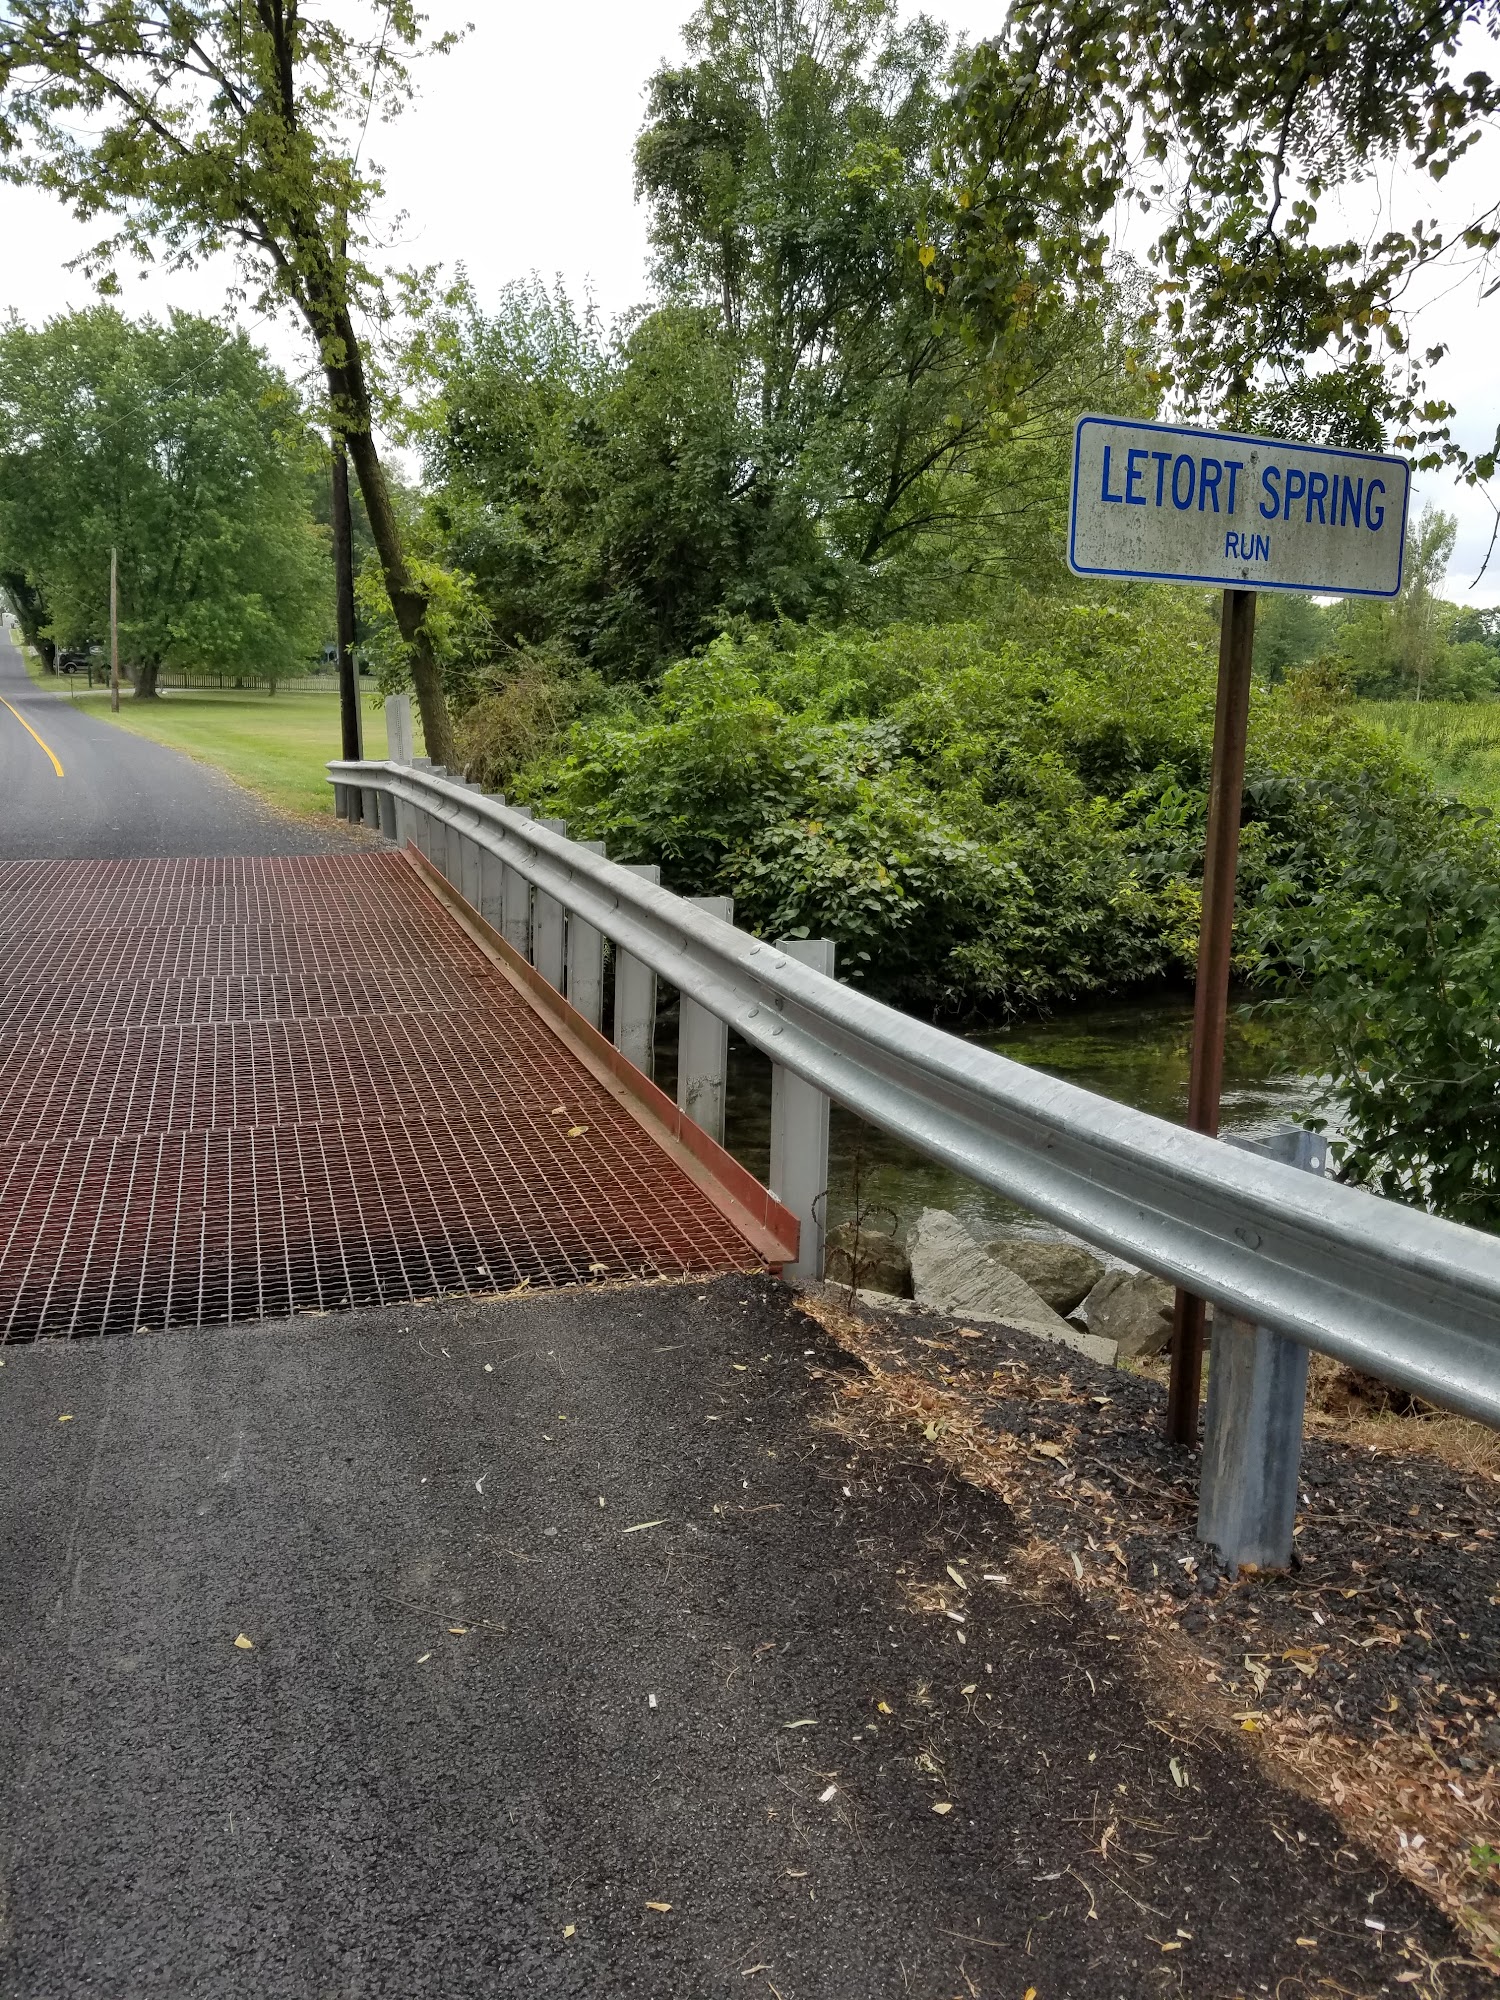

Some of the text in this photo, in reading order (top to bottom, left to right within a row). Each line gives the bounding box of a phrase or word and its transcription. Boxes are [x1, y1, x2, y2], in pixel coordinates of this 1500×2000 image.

[1101, 445, 1386, 532] LETORT SPRING
[1224, 531, 1270, 562] RUN
